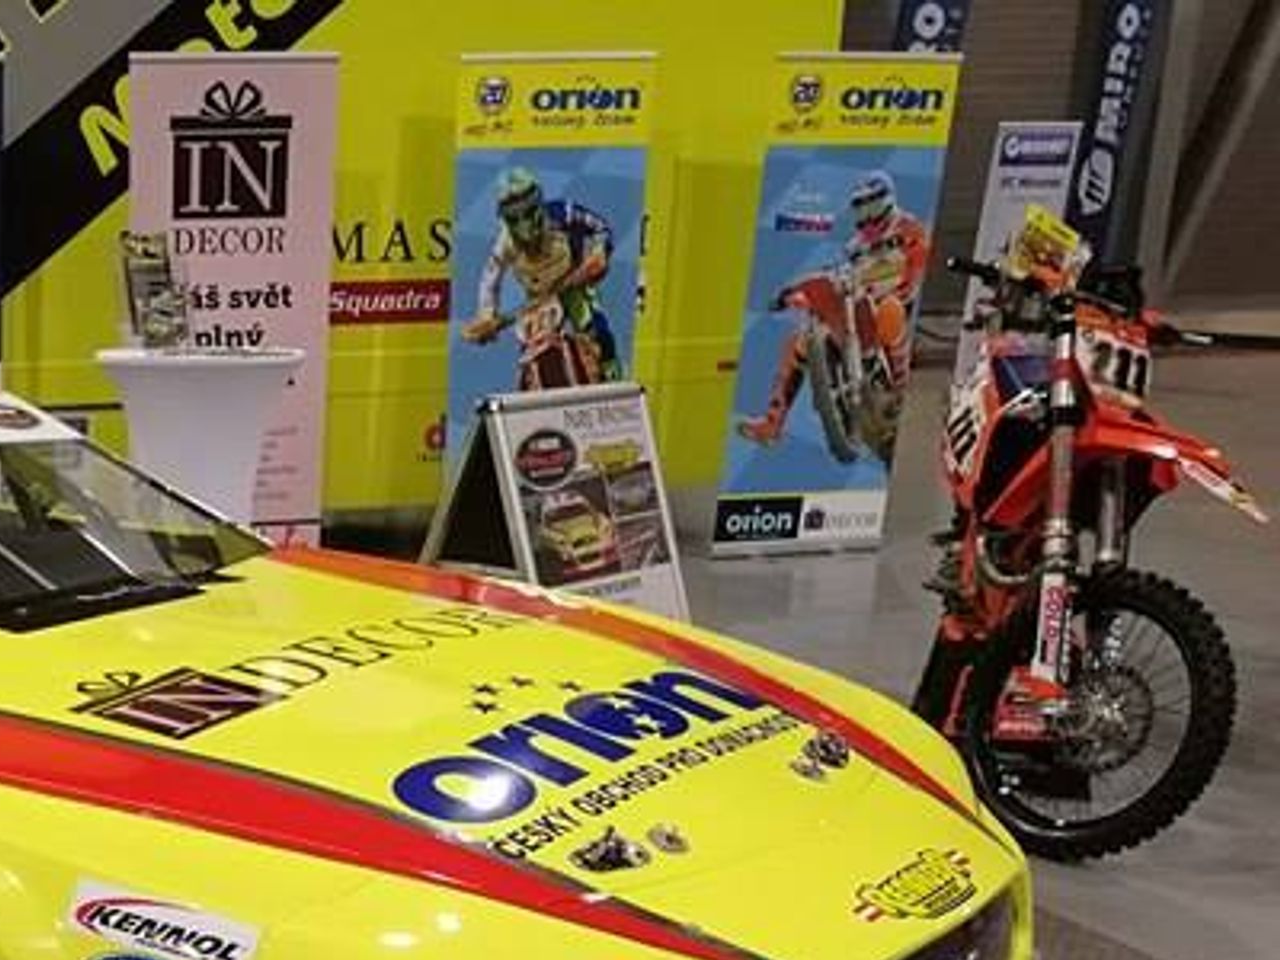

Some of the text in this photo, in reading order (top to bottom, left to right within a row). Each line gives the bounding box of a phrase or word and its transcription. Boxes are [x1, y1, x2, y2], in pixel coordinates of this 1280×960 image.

[531, 87, 642, 112] orion
[841, 86, 945, 110] orion
[179, 140, 283, 213] IN
[173, 226, 287, 255] DECOR
[227, 281, 293, 310] svět
[330, 289, 442, 317] Squadra
[725, 503, 793, 533] orion
[114, 677, 265, 736] IN
[392, 671, 766, 824] orion
